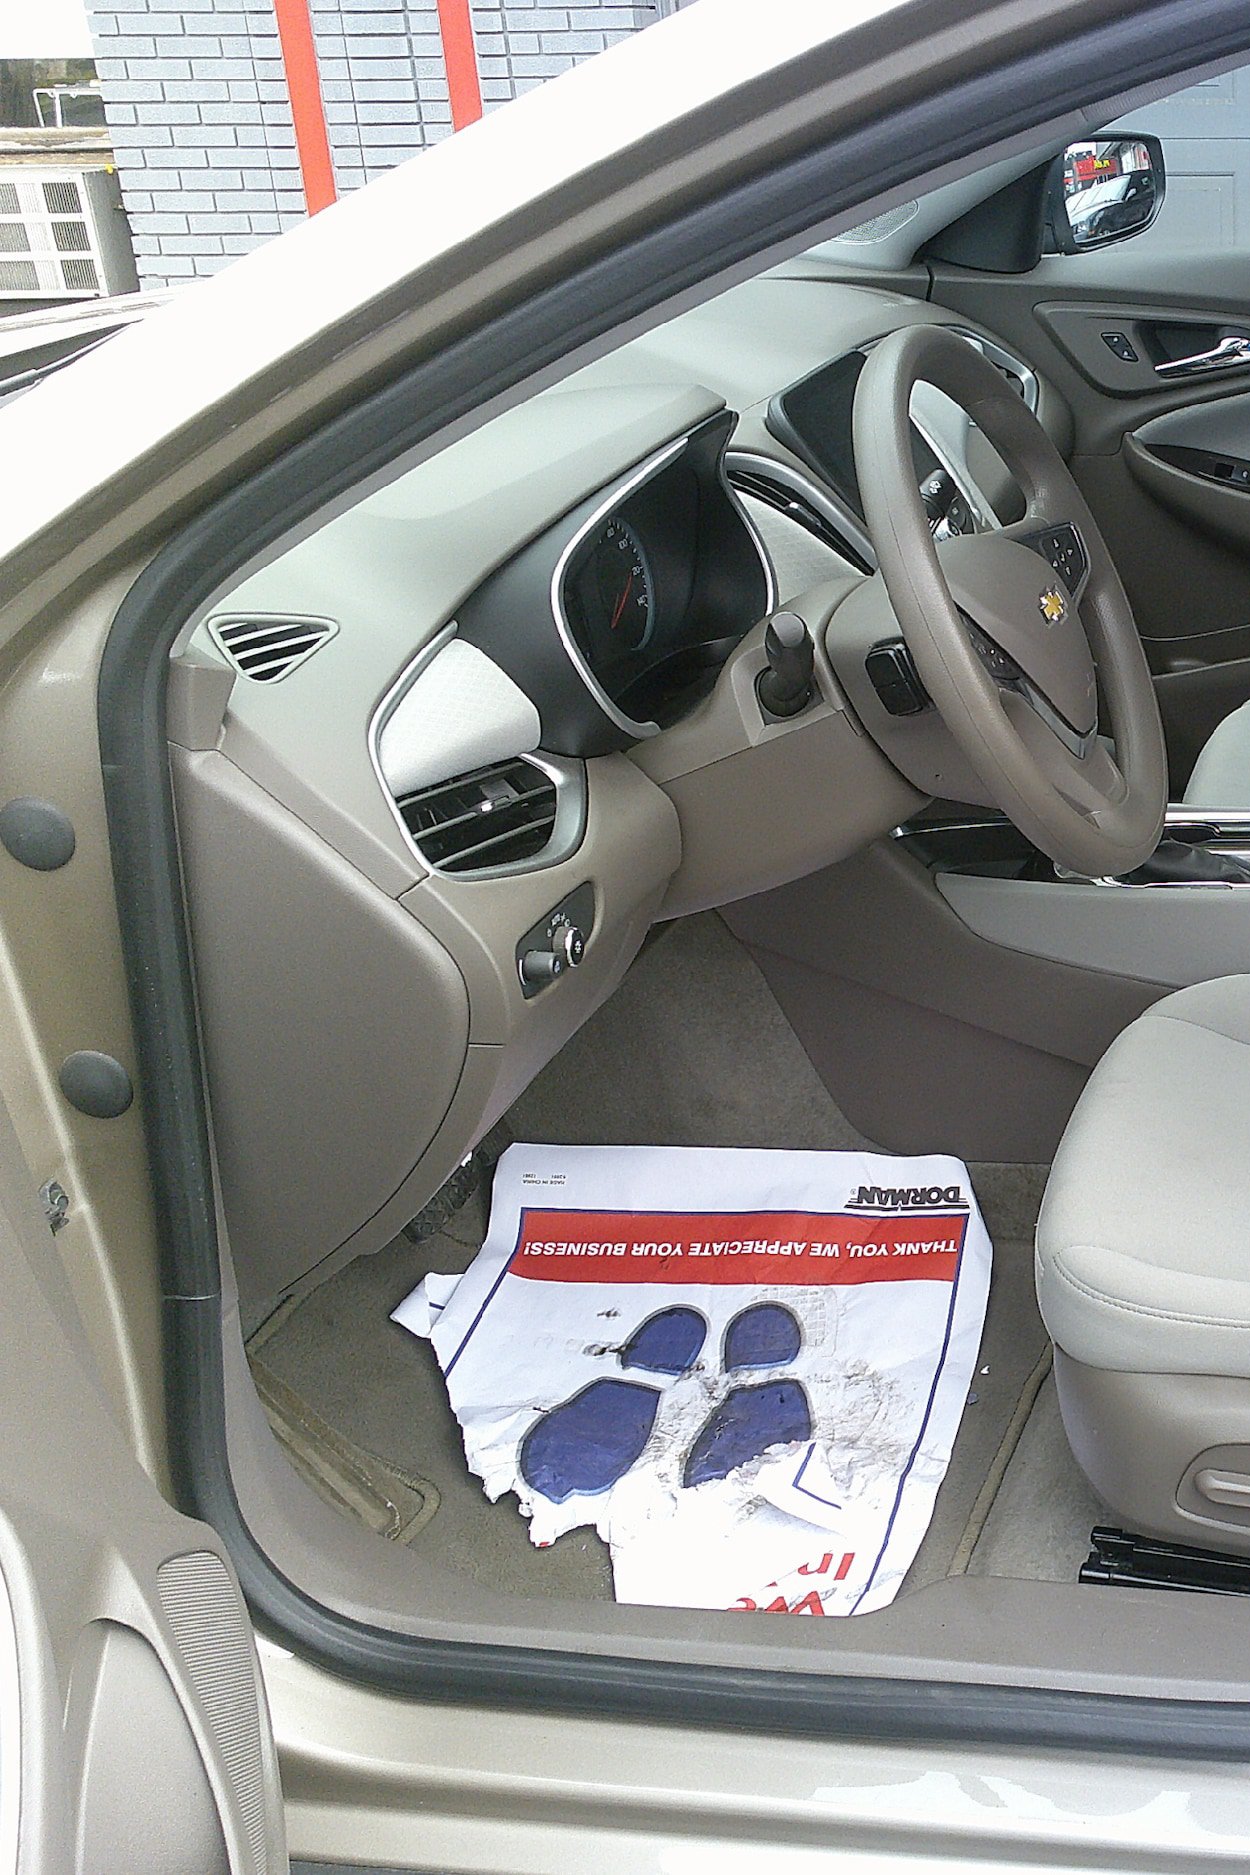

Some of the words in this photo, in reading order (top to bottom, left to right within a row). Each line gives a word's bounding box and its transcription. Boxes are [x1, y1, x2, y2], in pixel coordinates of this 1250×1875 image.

[856, 1186, 960, 1205] DORMAN
[523, 1241, 627, 1256] BUSINESS!
[631, 1242, 683, 1256] YOUR
[688, 1239, 807, 1256] APPRECIATE
[809, 1242, 840, 1258] WE
[846, 1242, 889, 1258] YOU,
[892, 1238, 958, 1256] THANK
